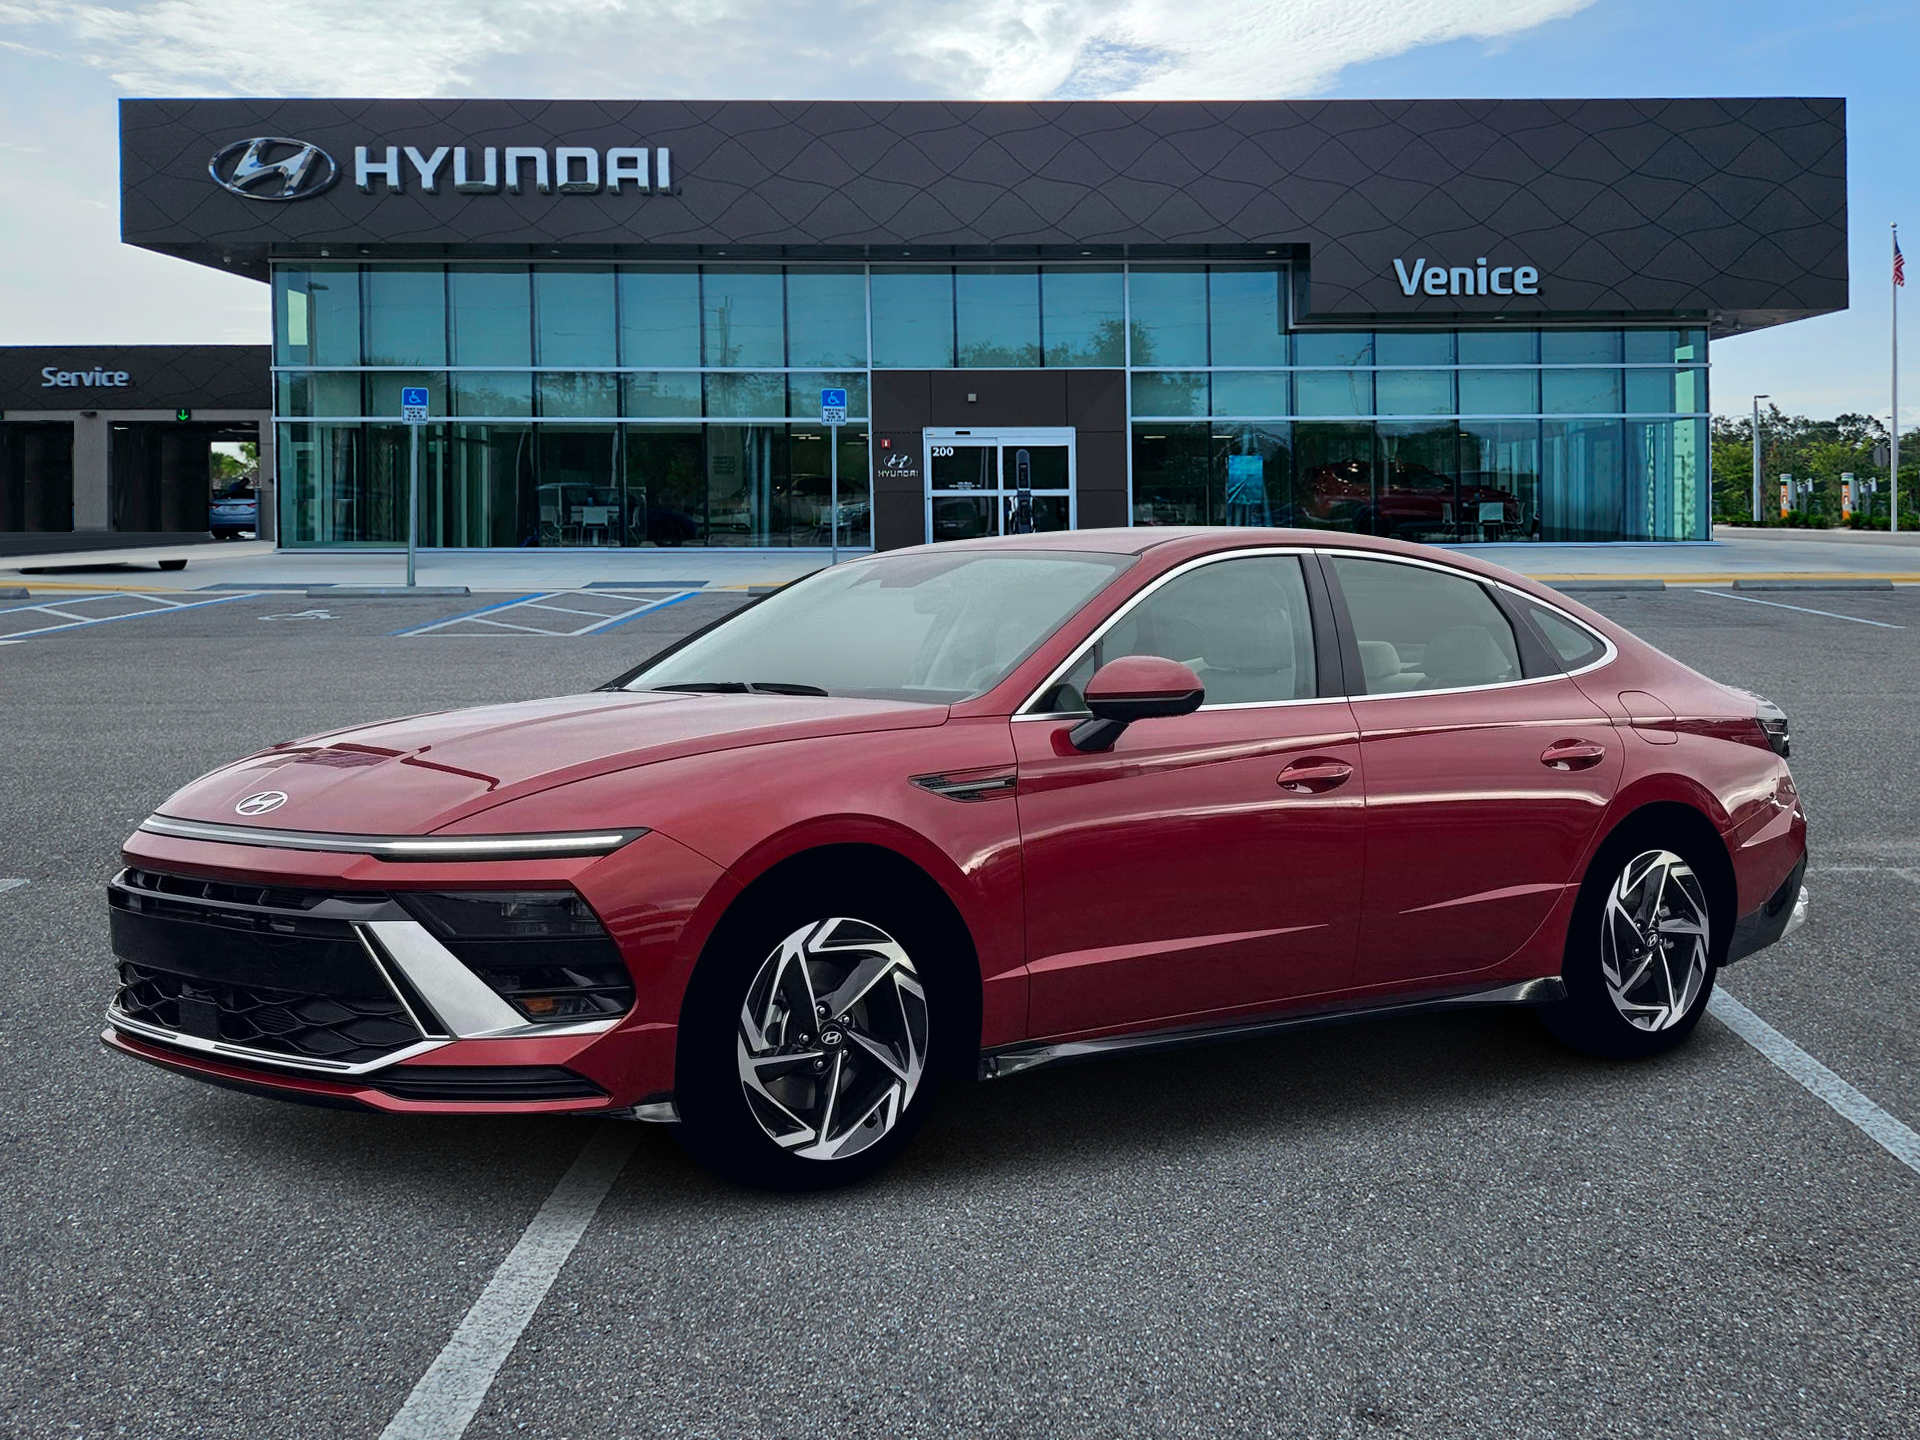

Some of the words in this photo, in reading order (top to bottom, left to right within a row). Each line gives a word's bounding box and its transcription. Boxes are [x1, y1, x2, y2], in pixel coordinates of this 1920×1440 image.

[354, 146, 673, 195] HYUNDAI
[1392, 257, 1539, 296] Venice
[41, 366, 130, 387] Service
[932, 446, 954, 457] 200
[877, 469, 919, 478] HYUNDAI
